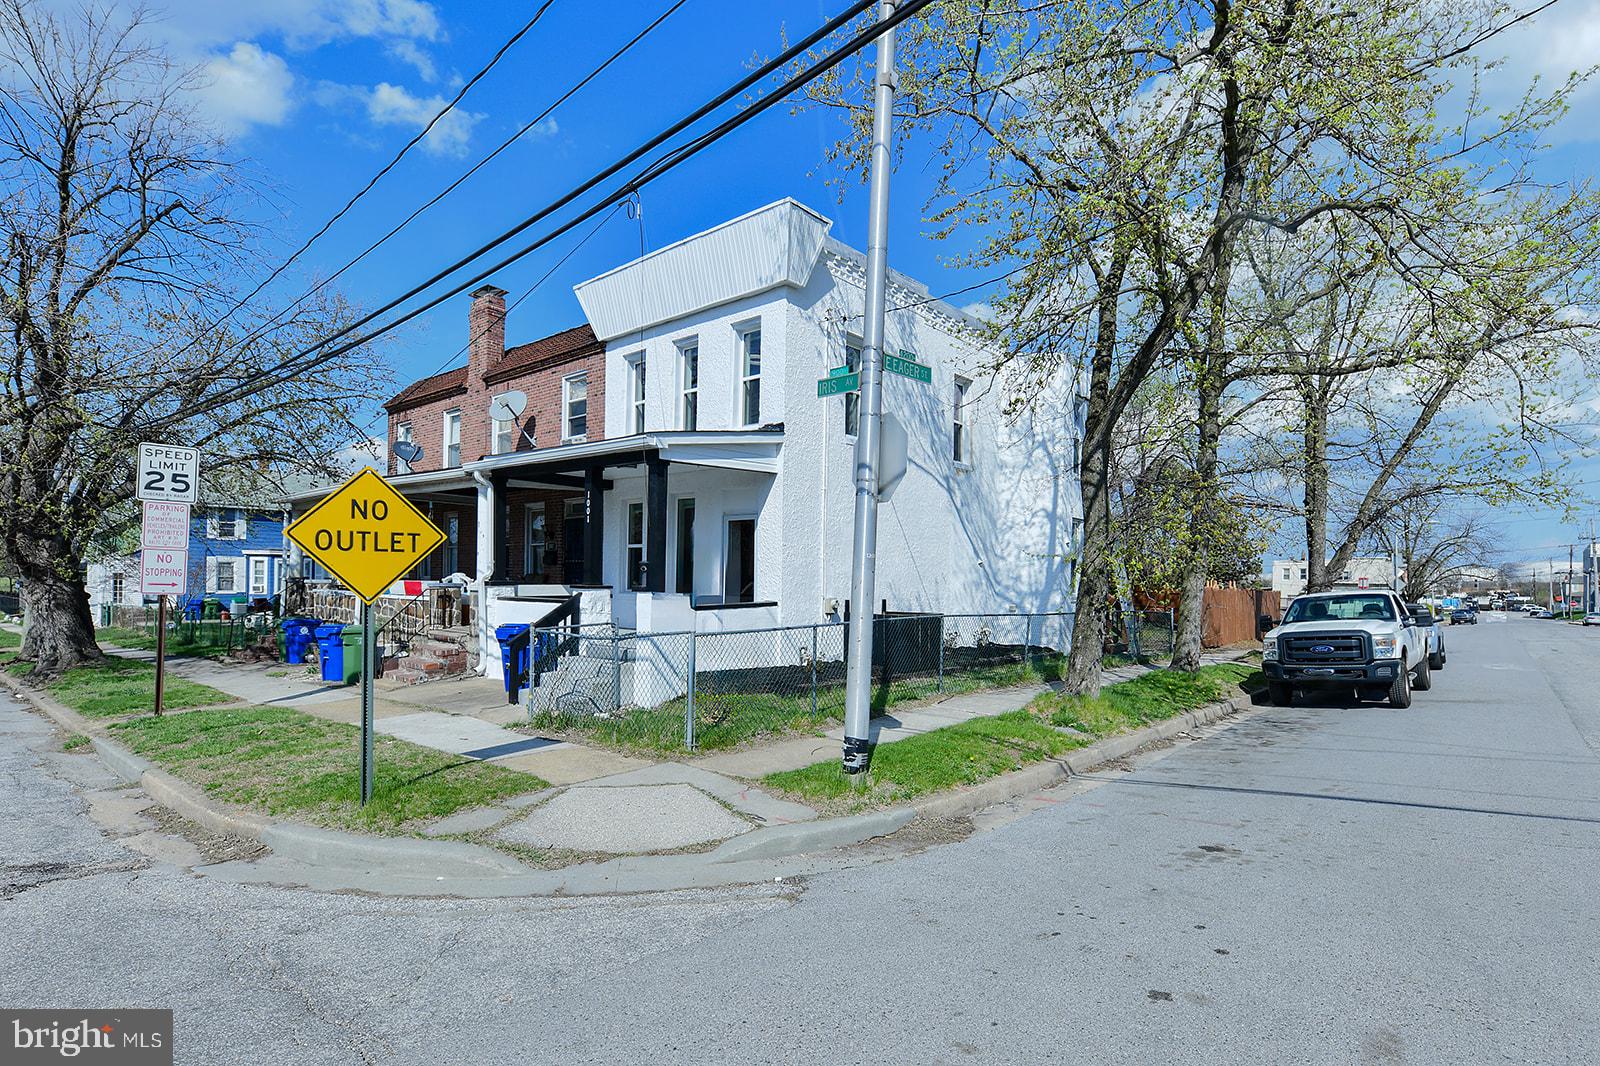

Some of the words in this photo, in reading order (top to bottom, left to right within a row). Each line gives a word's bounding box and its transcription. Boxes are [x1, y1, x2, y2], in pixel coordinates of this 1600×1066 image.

[885, 356, 892, 369] E
[893, 360, 920, 378] EAGER
[819, 380, 837, 397] IRIS
[845, 376, 854, 386] AV
[145, 448, 193, 460] SPEED
[150, 460, 186, 471] LIMIT
[144, 470, 190, 492] 25
[148, 504, 184, 512] PARKING
[351, 499, 388, 521] NO
[314, 530, 420, 552] OUTLET
[156, 554, 172, 563] NO
[145, 568, 182, 576] STOPPING
